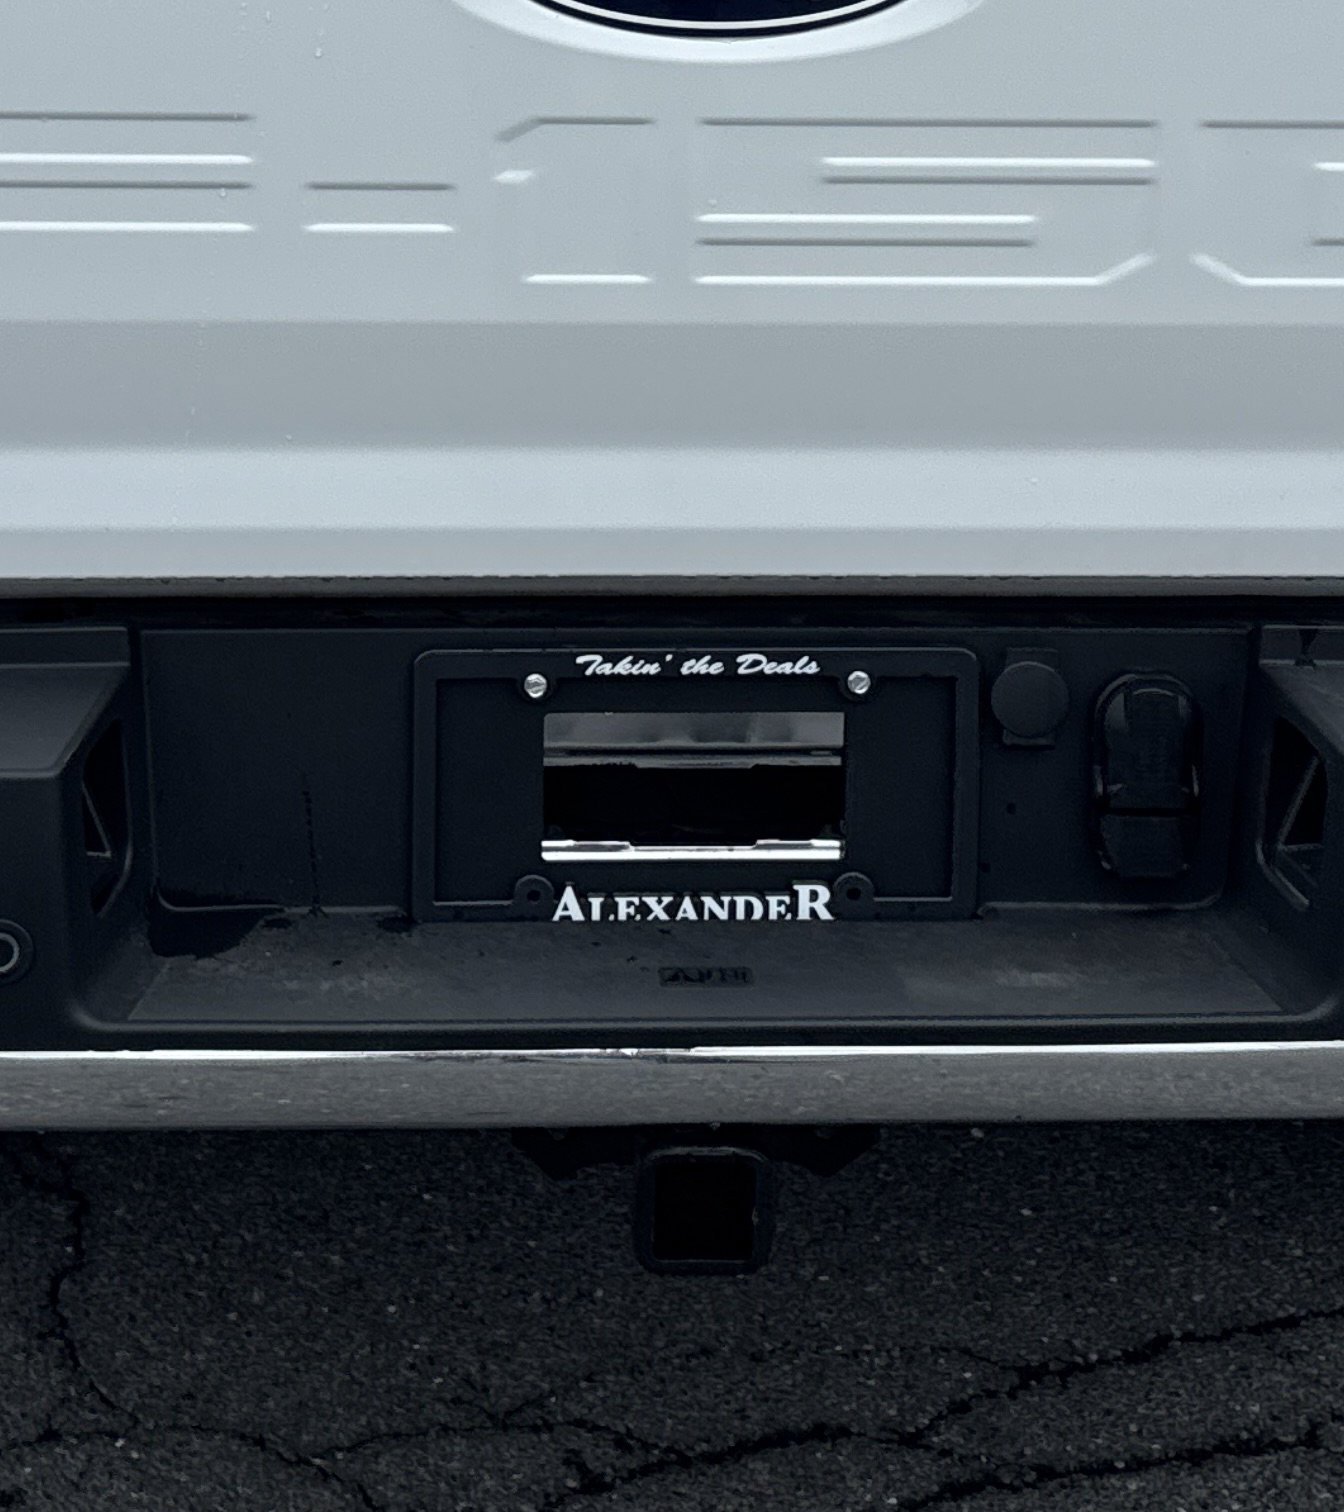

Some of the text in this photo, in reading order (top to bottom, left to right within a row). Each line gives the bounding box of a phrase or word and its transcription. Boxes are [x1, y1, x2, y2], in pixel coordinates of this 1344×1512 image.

[575, 653, 820, 676] Takin' the Deals
[552, 884, 835, 921] ALEXANDER
